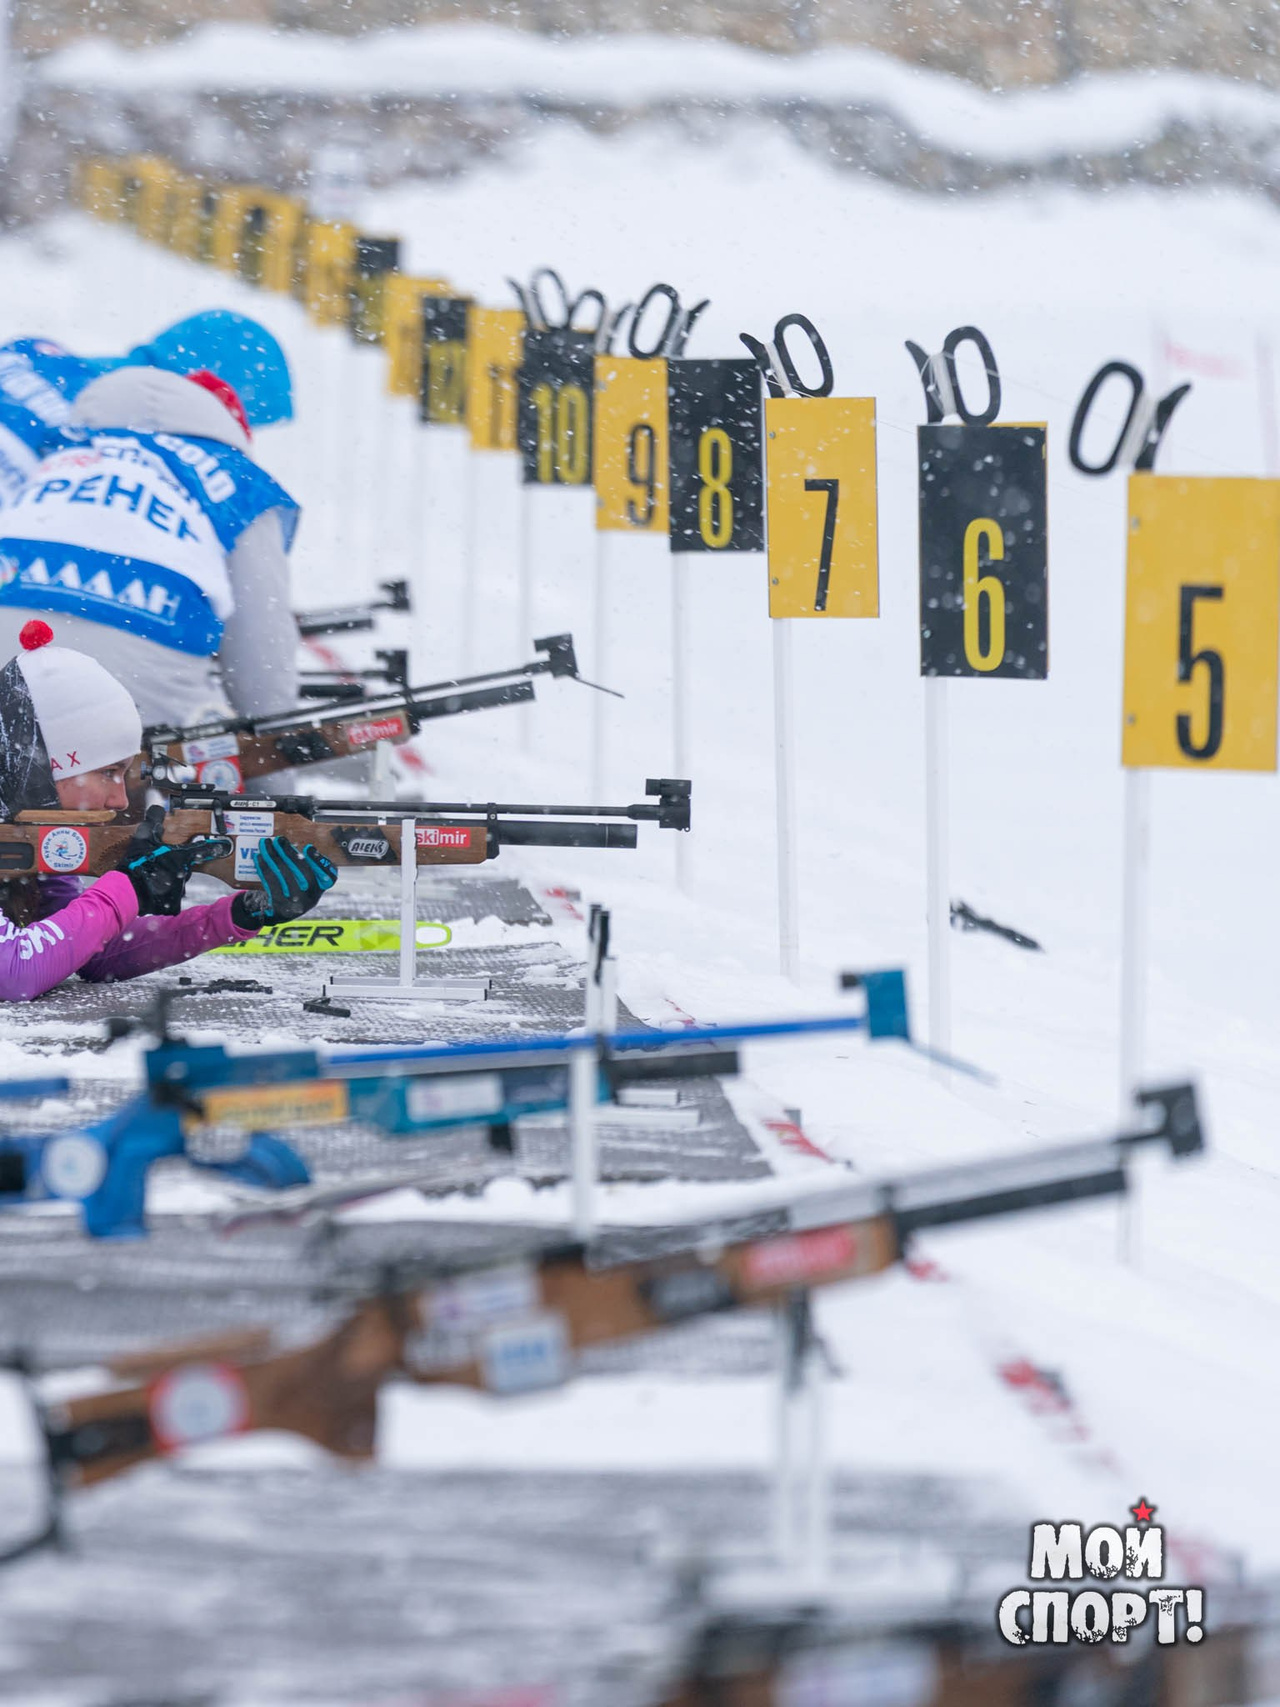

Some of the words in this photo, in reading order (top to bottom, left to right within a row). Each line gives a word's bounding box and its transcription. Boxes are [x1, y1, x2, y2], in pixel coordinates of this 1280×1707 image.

[533, 382, 588, 484] 10
[626, 424, 656, 527] 9
[699, 427, 733, 548] 8
[804, 478, 839, 612] 7
[963, 518, 1006, 672] 6
[1175, 585, 1226, 760] 5
[415, 828, 468, 846] skimir
